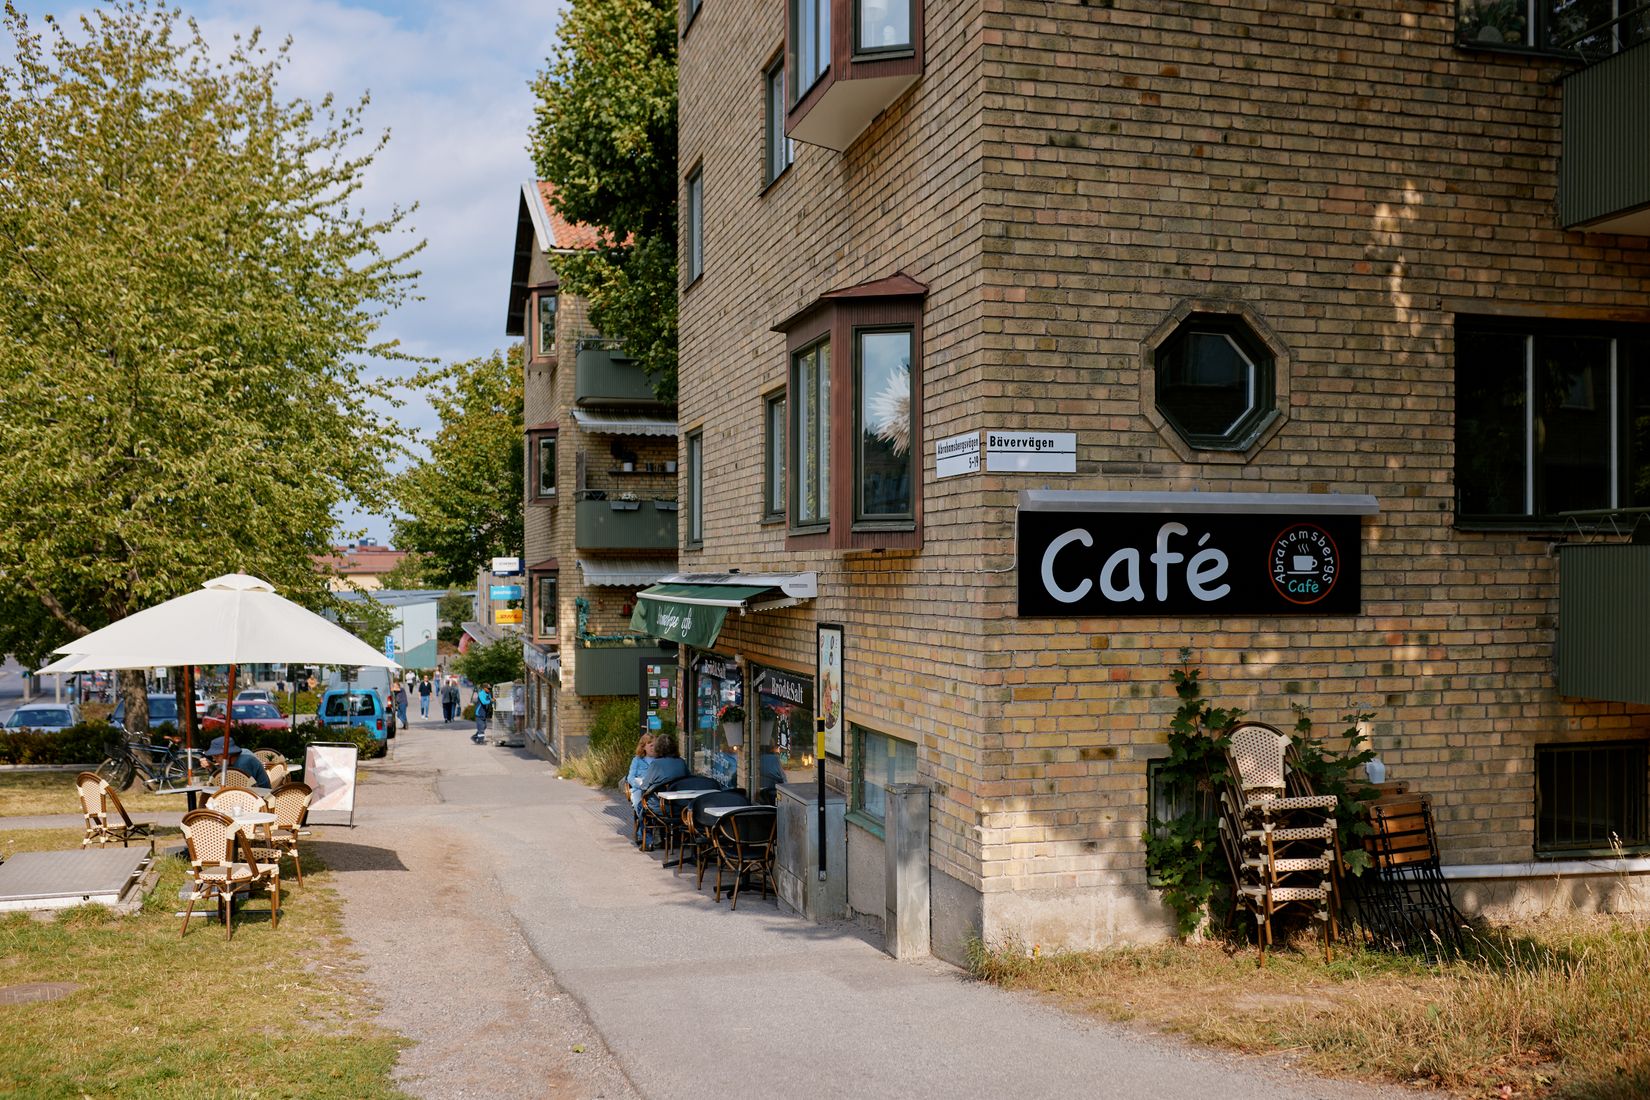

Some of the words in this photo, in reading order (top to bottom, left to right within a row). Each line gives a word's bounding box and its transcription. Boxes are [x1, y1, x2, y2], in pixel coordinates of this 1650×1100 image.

[937, 438, 979, 455] Abrahamsbergsvägen
[989, 435, 1054, 450] Bävervägen
[1041, 521, 1231, 603] Café
[1273, 530, 1335, 584] Abrahamsbergs
[1288, 578, 1320, 593] Café
